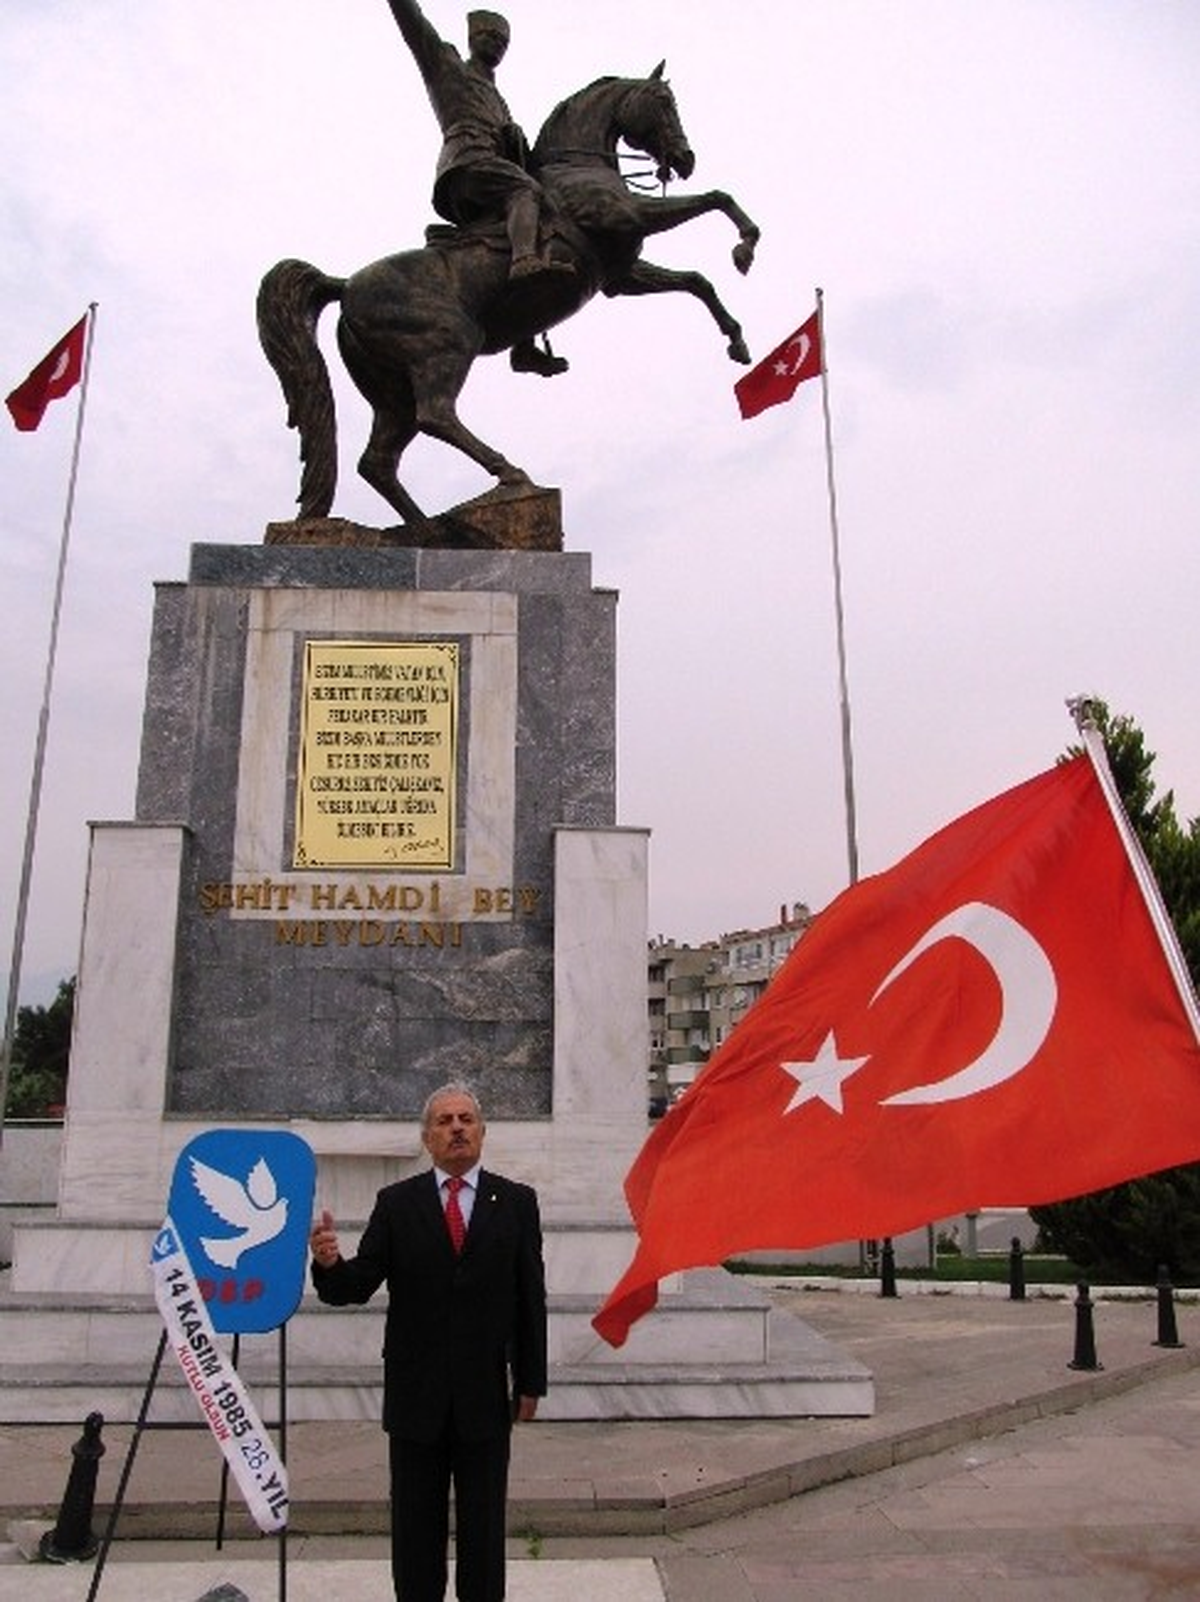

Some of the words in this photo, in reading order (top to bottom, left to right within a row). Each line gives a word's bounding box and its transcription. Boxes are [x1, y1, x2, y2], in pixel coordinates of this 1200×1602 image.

[310, 880, 441, 913] HAMDİ
[472, 885, 541, 915] BEY
[276, 917, 463, 948] MEYDANI
[164, 1267, 190, 1298] 14
[176, 1297, 222, 1379] KASIM
[177, 1344, 204, 1393] KUTLU
[201, 1393, 231, 1442] OLSUN
[211, 1380, 254, 1438] 1985
